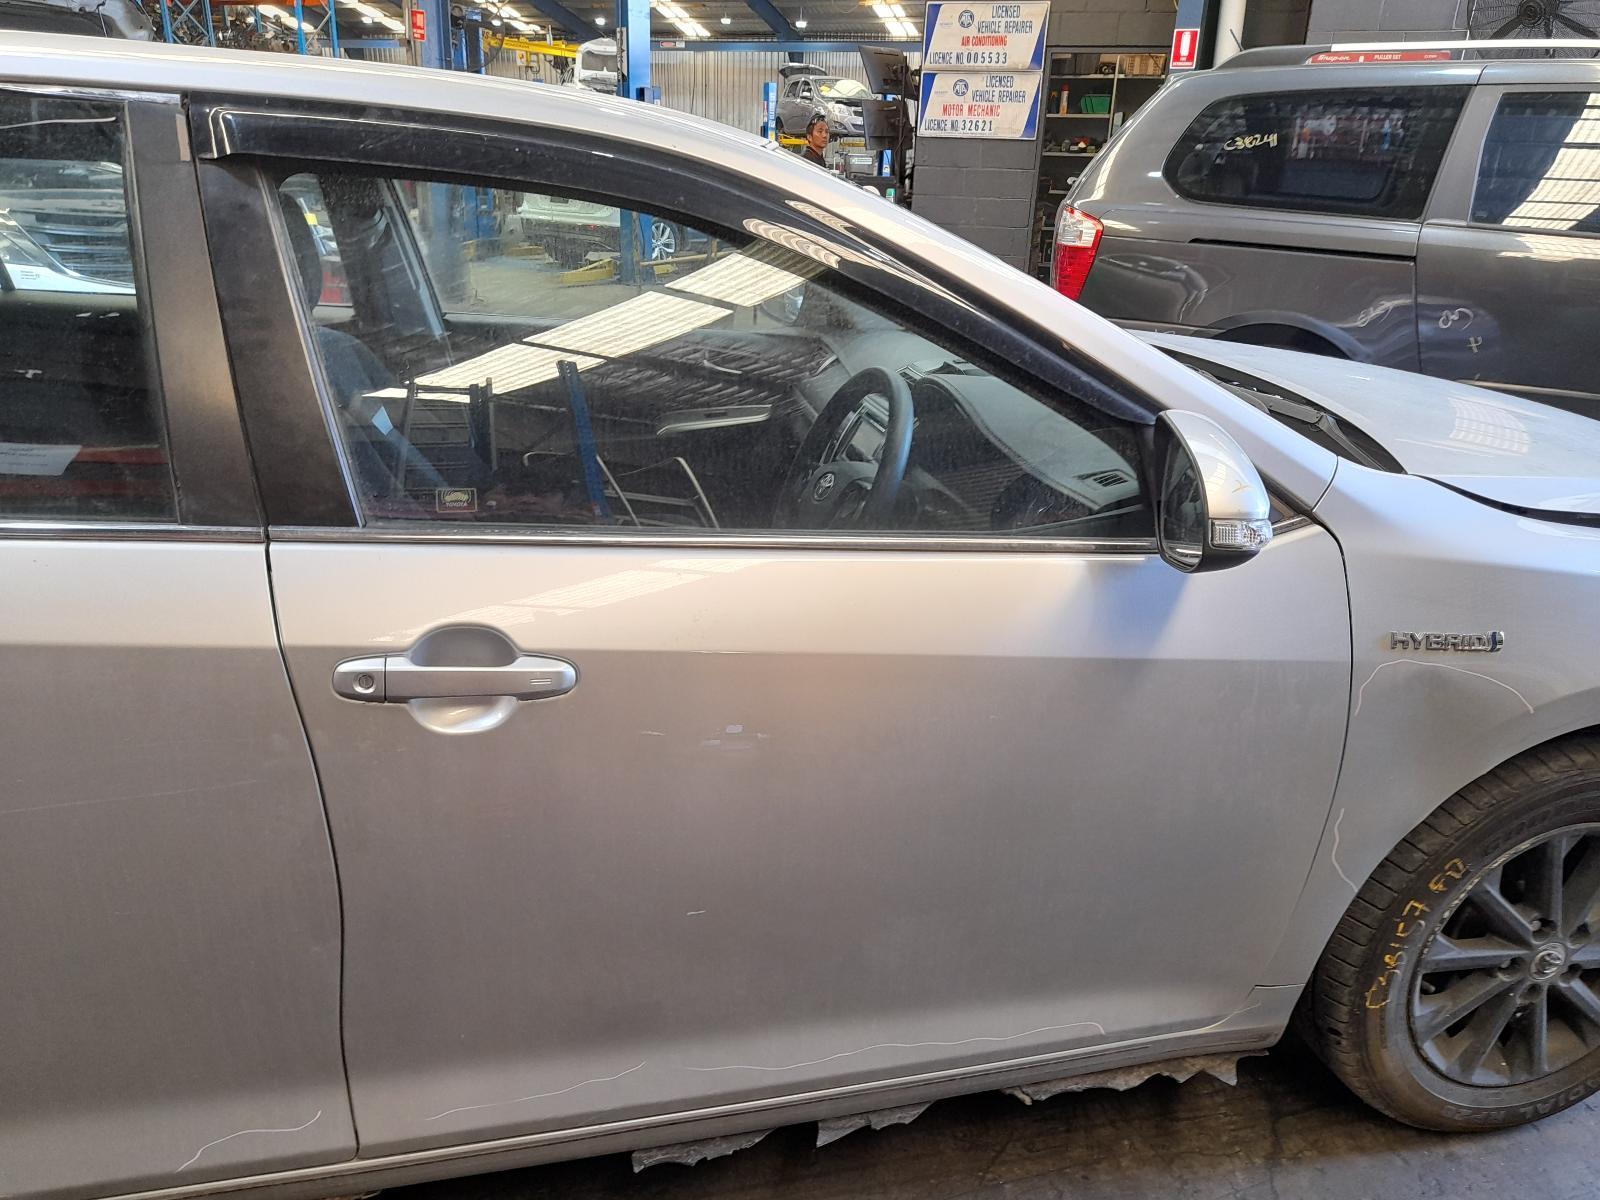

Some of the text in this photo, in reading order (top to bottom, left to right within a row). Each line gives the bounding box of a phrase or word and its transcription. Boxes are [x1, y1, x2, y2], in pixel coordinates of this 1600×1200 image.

[991, 5, 1021, 19] LICENSED
[977, 21, 1033, 34] VEHICLE REPAIRER
[961, 35, 1008, 46] AIR CONDITIONING
[929, 52, 953, 64] LICENCE
[1317, 54, 1351, 62] Snap-on
[985, 75, 1014, 88] LICENSED
[972, 90, 1026, 103] VEHICLE REPAIRER
[942, 104, 1001, 117] MOTOR MECHANIC
[924, 119, 948, 131] LICENCE
[961, 119, 993, 131] 32621
[1390, 631, 1491, 652] HYBRID
